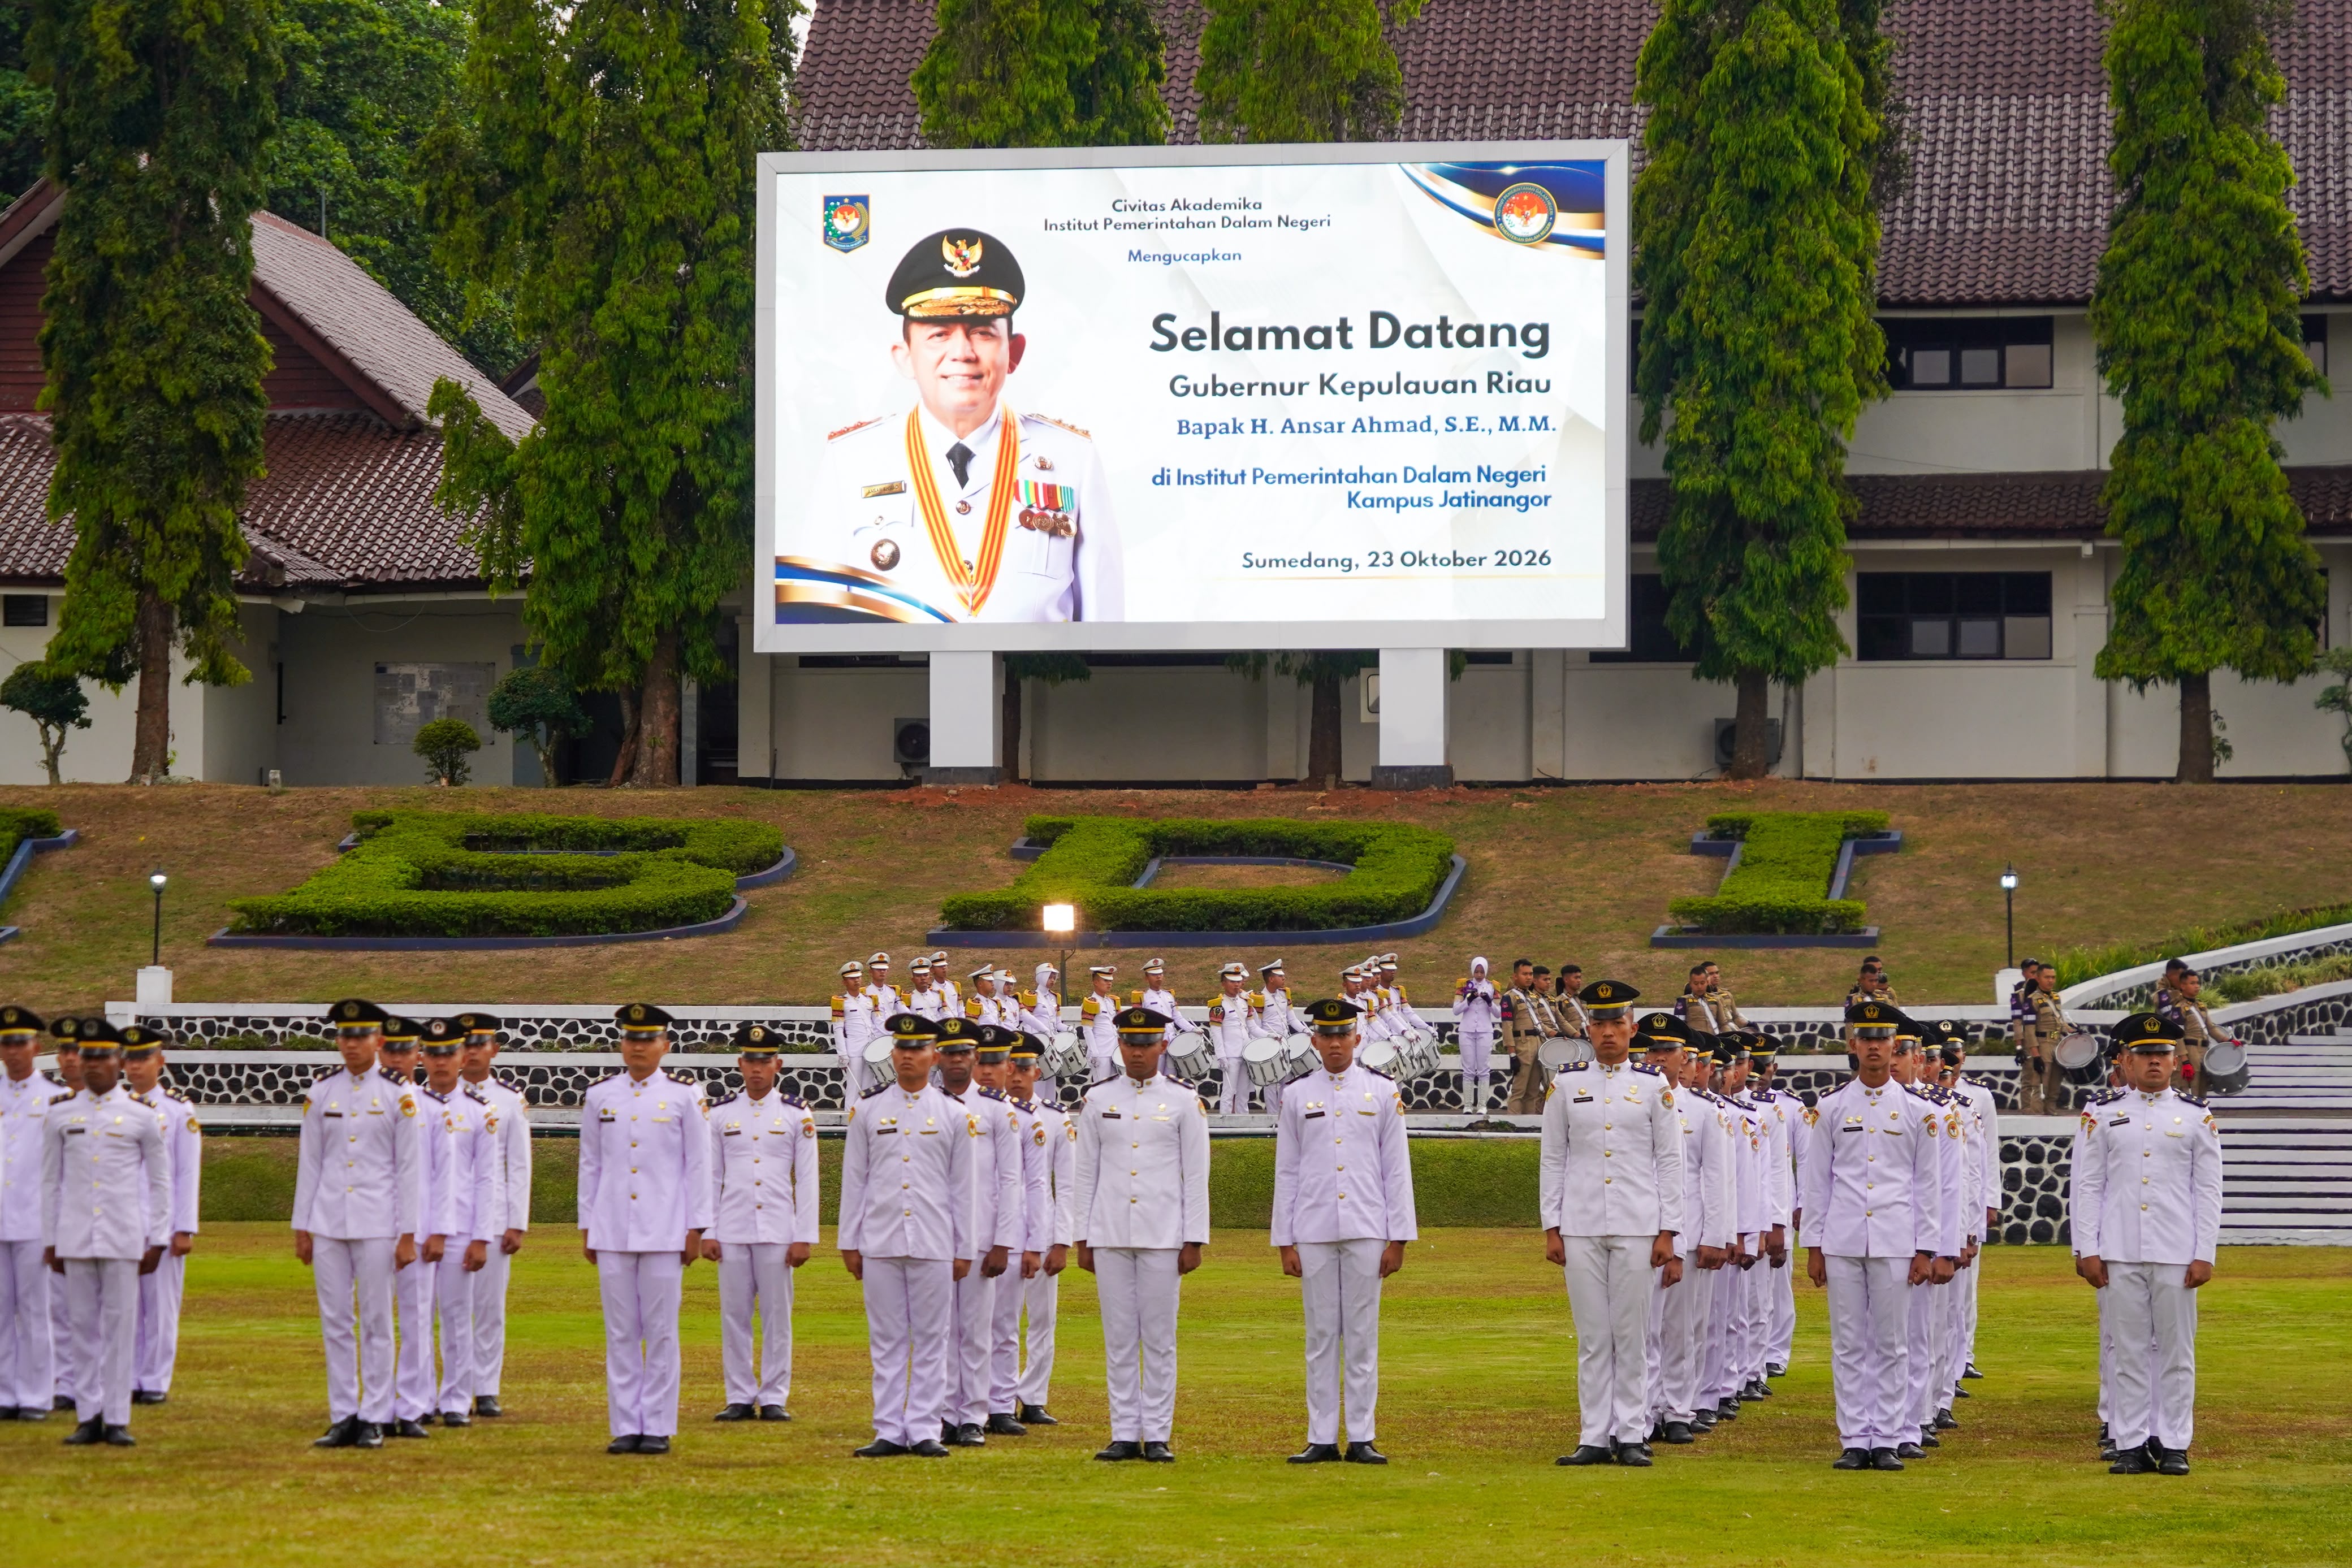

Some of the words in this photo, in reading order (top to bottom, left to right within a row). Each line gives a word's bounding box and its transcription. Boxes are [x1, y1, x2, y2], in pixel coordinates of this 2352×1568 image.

[1112, 199, 1166, 213] Civitas
[1170, 197, 1263, 211] Akademika
[1044, 218, 1099, 231] Institut
[1104, 216, 1216, 231] Pemerintahan
[1221, 215, 1273, 229] Dalam
[1278, 214, 1331, 232] Negeri
[1128, 248, 1242, 266] Mengucapkan
[1149, 311, 1354, 353] Selamat
[1370, 310, 1550, 360] Datang
[1169, 374, 1311, 398] Gubernur
[1320, 371, 1477, 402] Kepulauan
[1487, 370, 1551, 395] Riau
[1177, 417, 1245, 440] Bapak
[1251, 418, 1274, 435] H.
[1280, 418, 1346, 434] Ansar
[1351, 415, 1439, 437] Ahmad,
[1445, 415, 1493, 436] S.E.,
[1498, 415, 1557, 432] M.M.
[1151, 467, 1171, 486] di
[1177, 468, 1247, 486] Institut
[1252, 465, 1398, 486] Pemerintahan
[1403, 464, 1472, 484] Dalam
[1477, 464, 1546, 489] Negeri
[1348, 490, 1434, 514] Kampus
[1439, 490, 1553, 513] Jatinangor
[1242, 551, 1360, 573] Sumedang,
[1368, 551, 1394, 568] 23
[1400, 549, 1488, 568] Oktober
[1494, 549, 1552, 567] 2026
